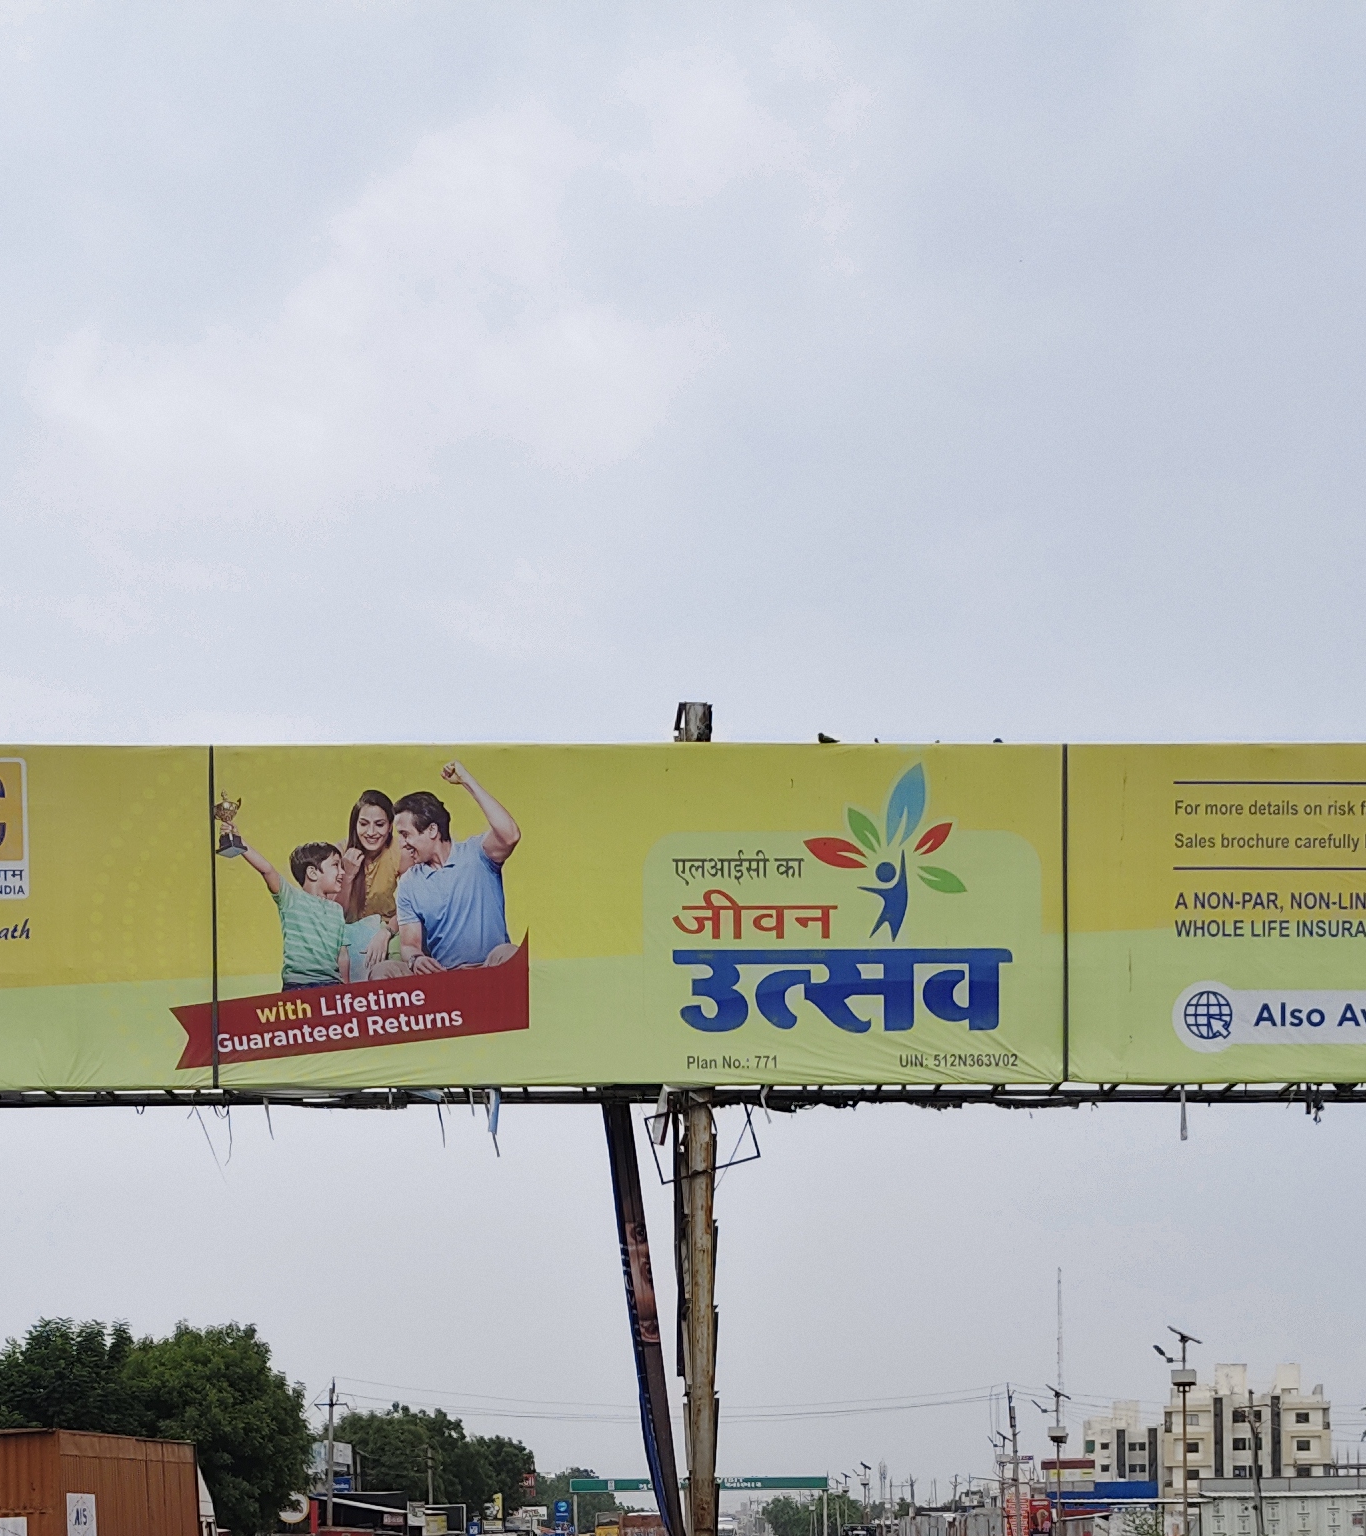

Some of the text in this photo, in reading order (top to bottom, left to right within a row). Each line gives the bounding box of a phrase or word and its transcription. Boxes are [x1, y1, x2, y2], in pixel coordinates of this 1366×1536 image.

[1174, 800, 1200, 816] For
[1204, 803, 1244, 816] more
[1248, 800, 1299, 817] details
[1303, 803, 1322, 816] on
[1327, 800, 1355, 816] risk
[1174, 833, 1216, 849] Sales
[1220, 833, 1290, 849] brochure
[1294, 833, 1360, 852] carefully
[672, 850, 804, 885] एलआईसी का
[1174, 892, 1188, 910] A
[1193, 892, 1284, 913] NON-PAR,
[672, 889, 838, 940] जीवन
[1175, 919, 1245, 938] WHOLE
[1250, 919, 1290, 938] LIFE
[672, 948, 1013, 1034] उत्सव
[256, 989, 426, 1024] with Lifetime
[1253, 1002, 1326, 1028] Also
[217, 1009, 464, 1053] Guaranteed Returns
[686, 1055, 720, 1070] Plan
[754, 1055, 778, 1069] 771
[899, 1053, 1019, 1068] UIN: 512N363V02
[74, 1508, 88, 1526] AIS
